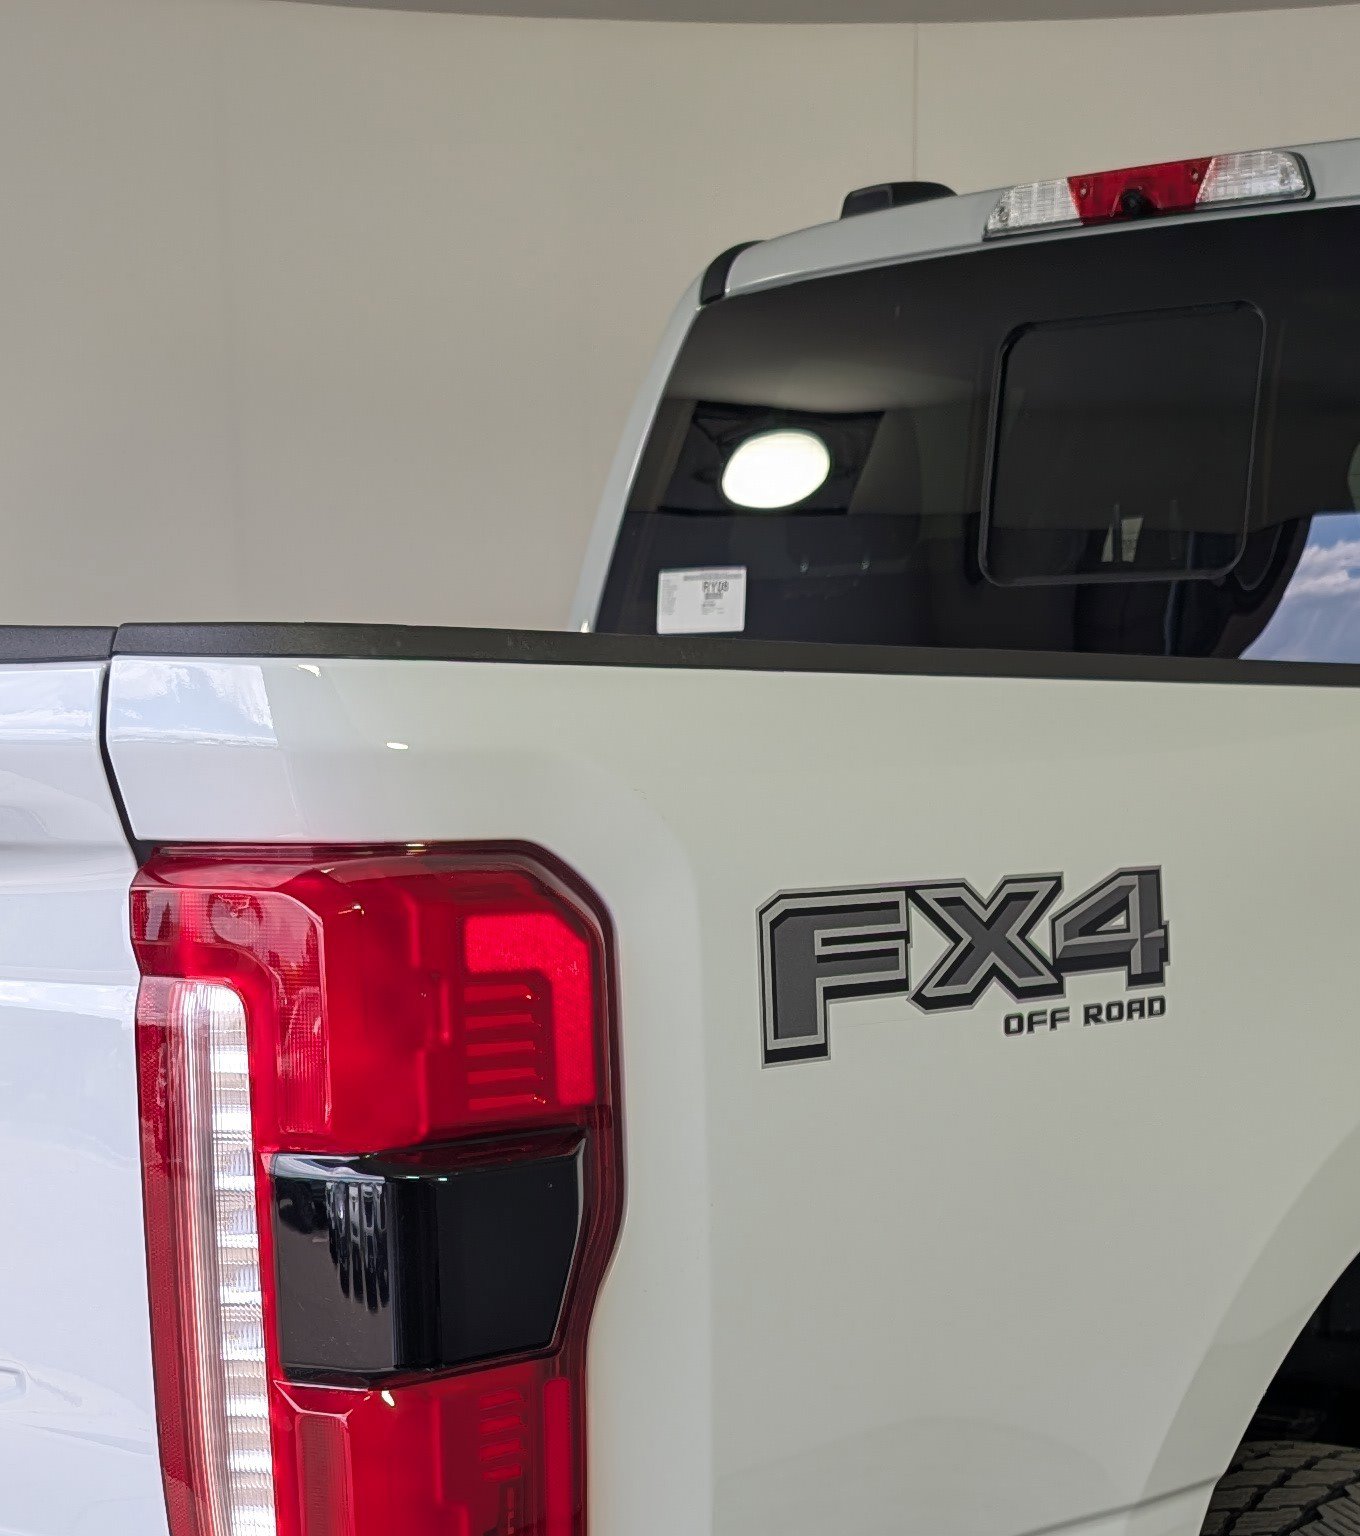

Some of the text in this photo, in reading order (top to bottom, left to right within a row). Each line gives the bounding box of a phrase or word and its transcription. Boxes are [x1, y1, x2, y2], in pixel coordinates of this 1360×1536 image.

[756, 865, 1170, 1069] FX4
[1003, 995, 1167, 1037] OFF ROAD
